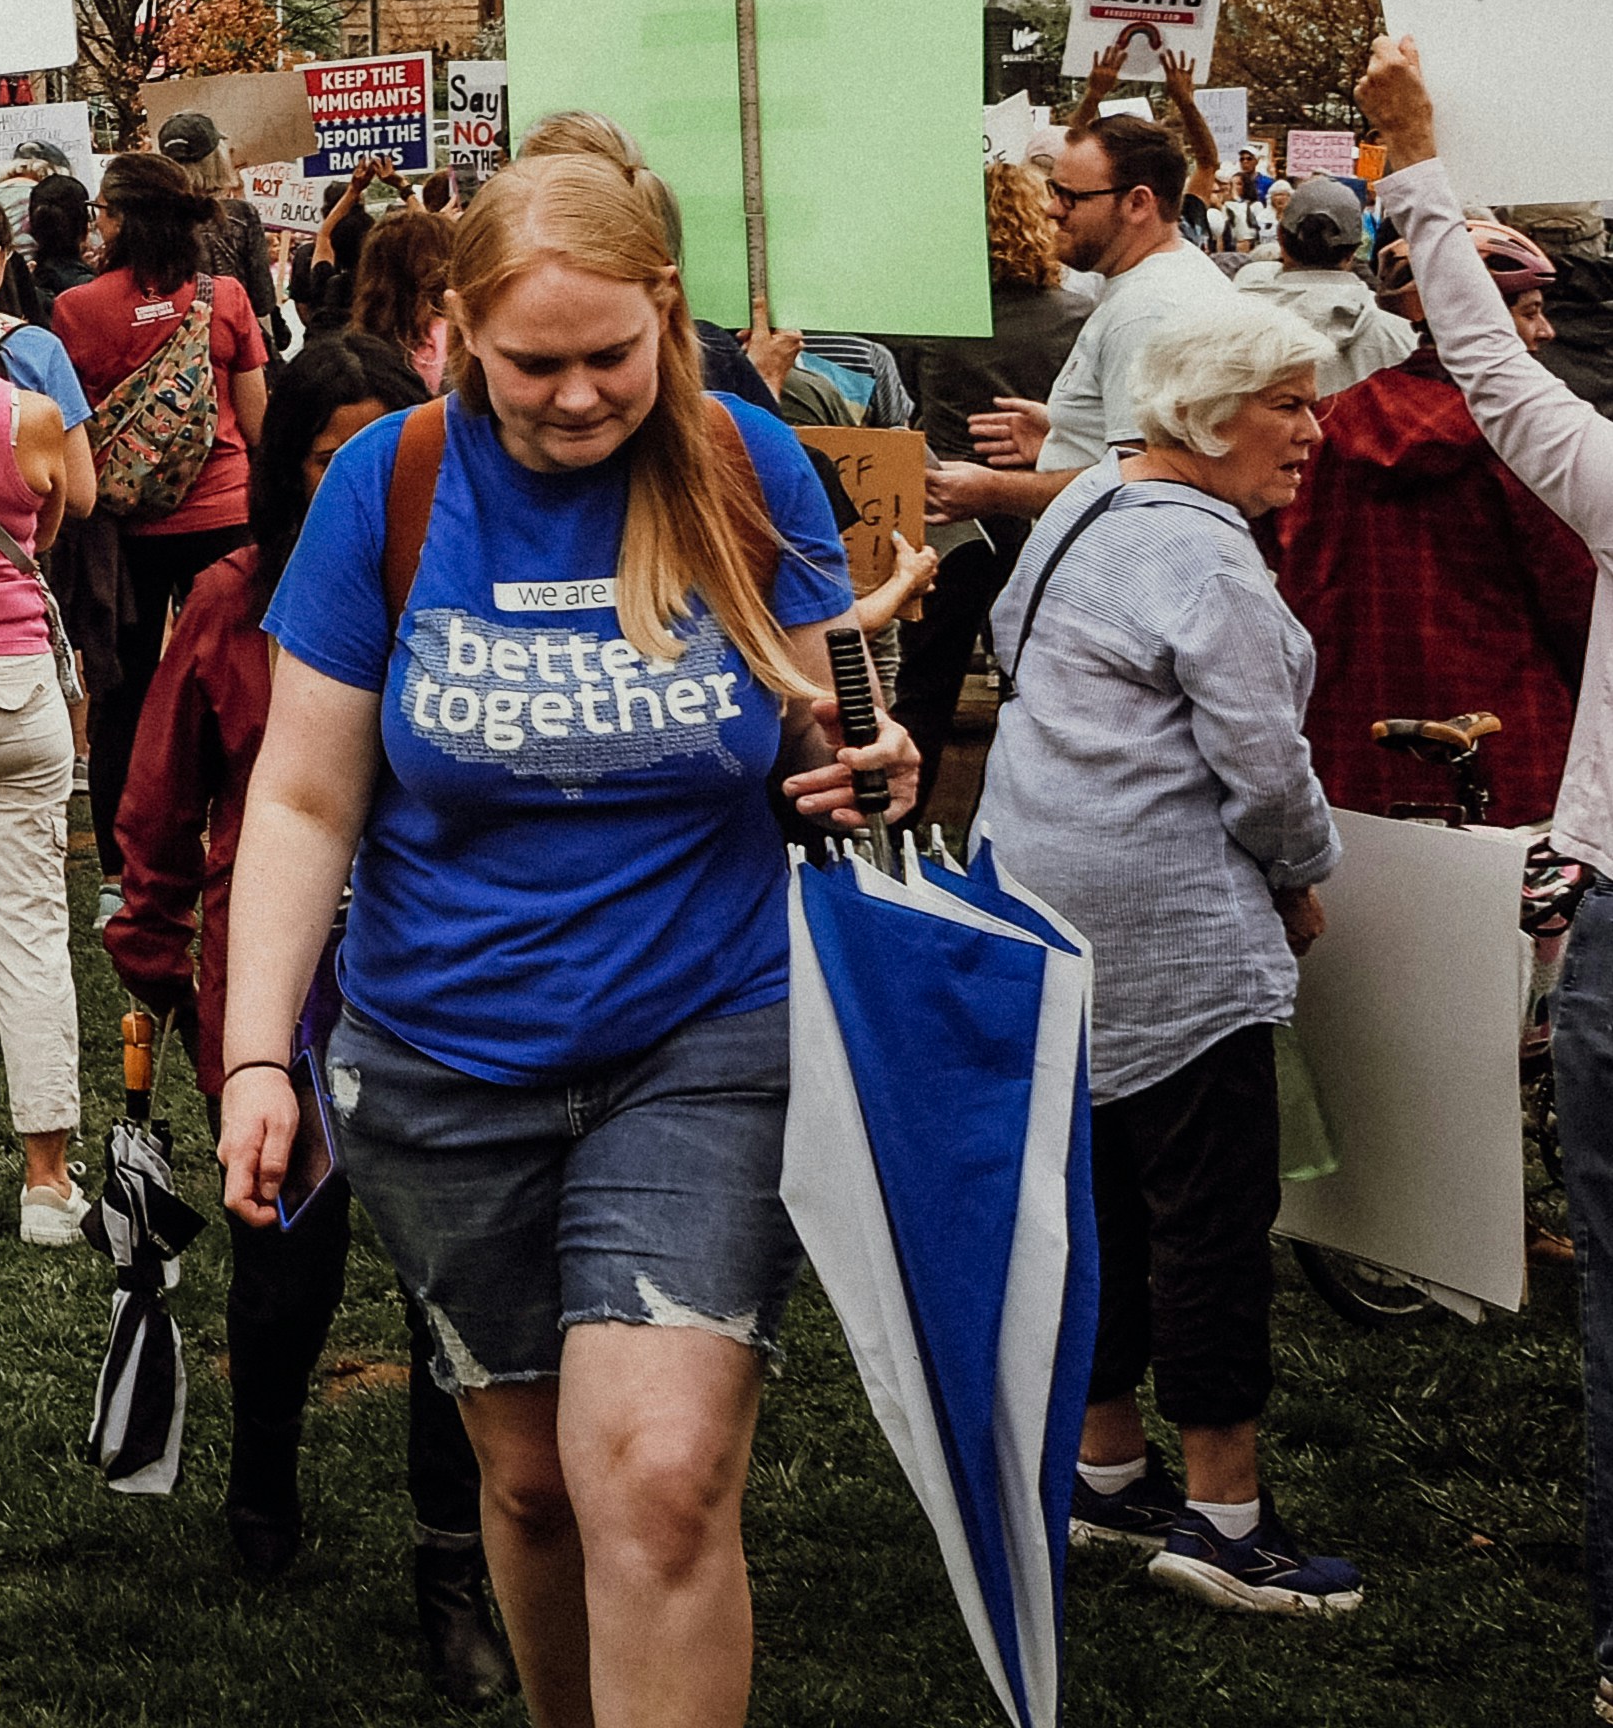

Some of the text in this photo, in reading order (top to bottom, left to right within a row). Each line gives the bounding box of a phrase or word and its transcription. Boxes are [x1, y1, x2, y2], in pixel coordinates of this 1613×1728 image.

[321, 65, 406, 91] KEEP THE
[307, 86, 422, 114] IMMIGRANTS
[450, 74, 499, 121] Say
[384, 124, 421, 144] THE
[453, 120, 494, 148] NO
[253, 177, 315, 202] NOT THE
[280, 202, 320, 224] BLACK
[518, 582, 608, 607] we are
[413, 672, 742, 751] together
